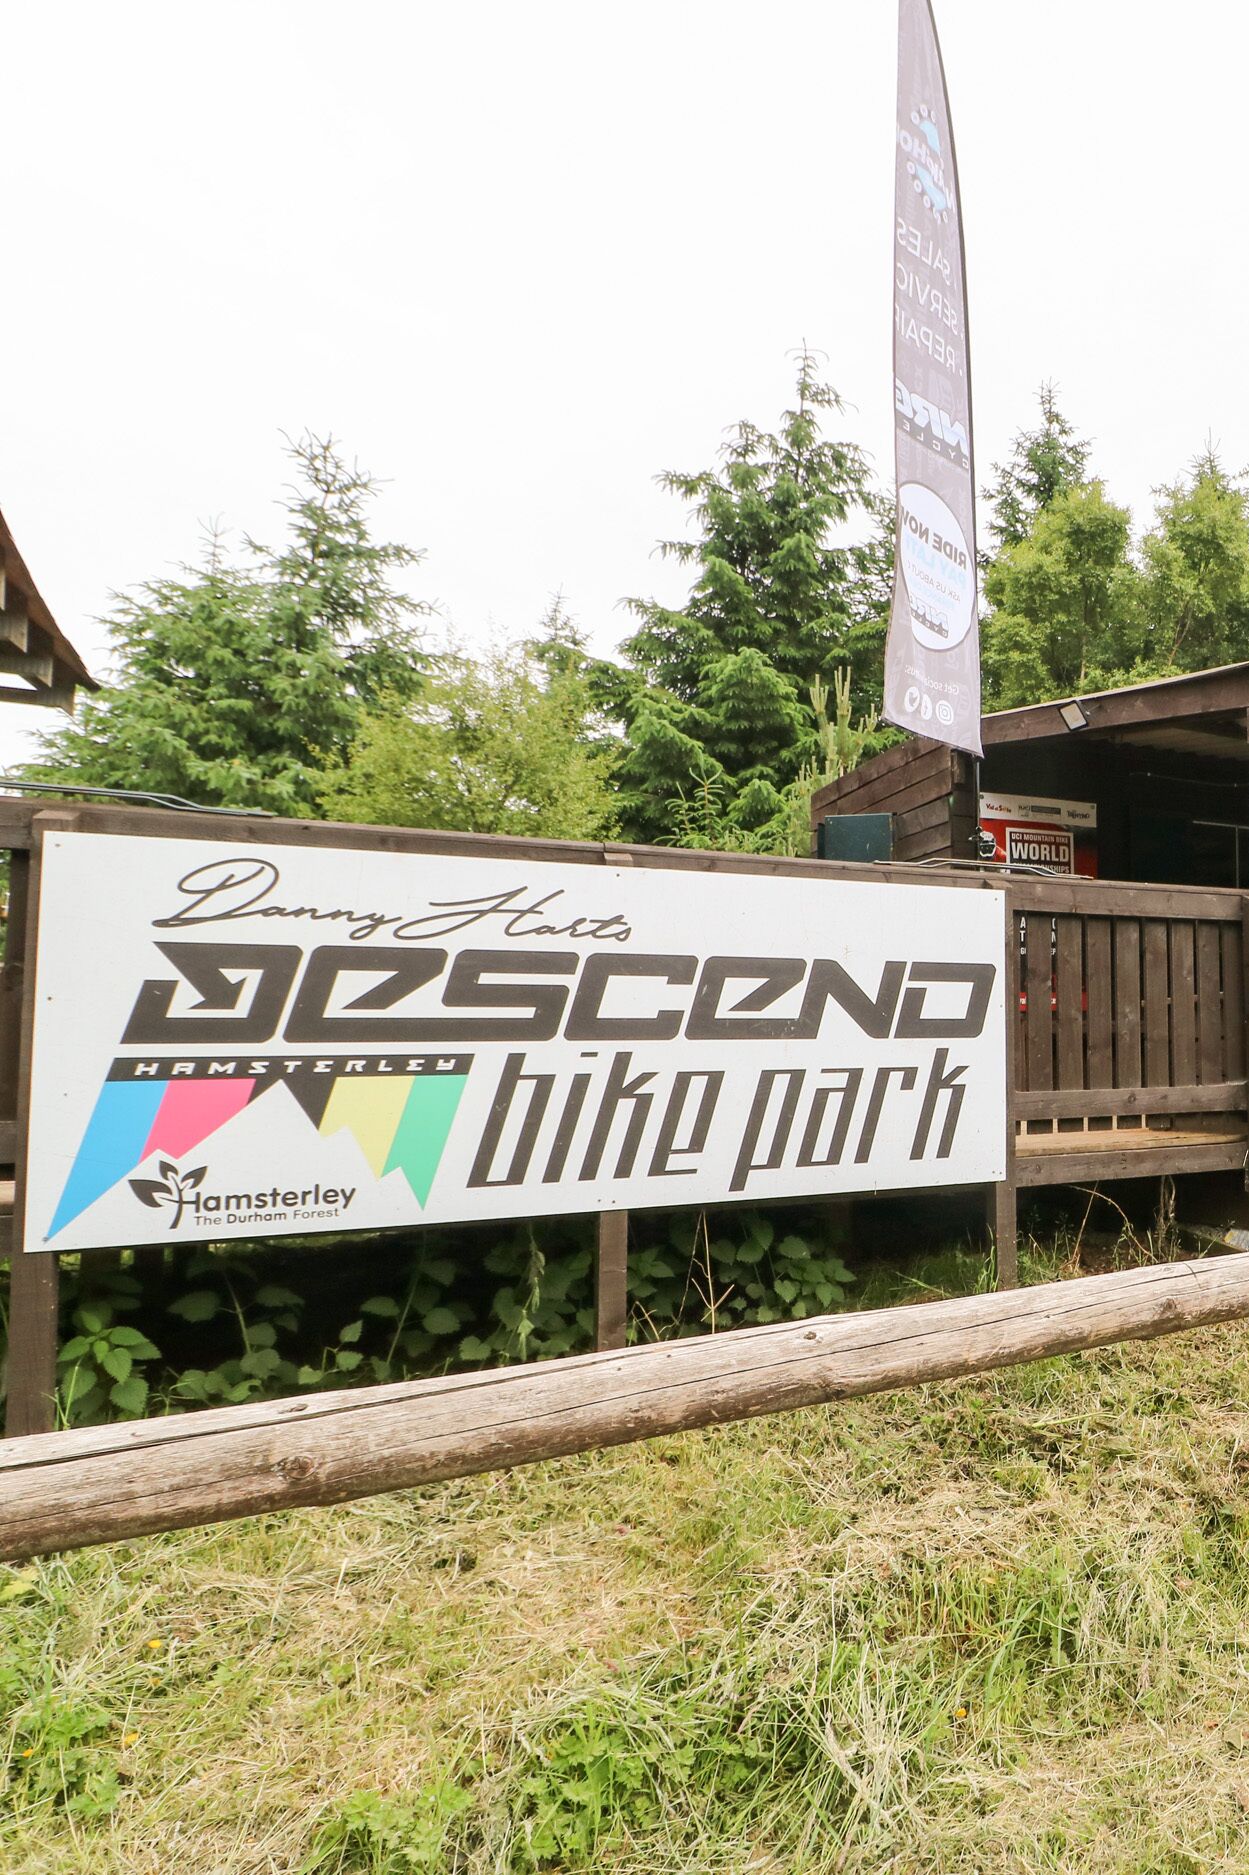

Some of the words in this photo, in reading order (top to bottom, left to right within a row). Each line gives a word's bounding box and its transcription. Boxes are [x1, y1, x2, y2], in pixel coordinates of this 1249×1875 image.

[1011, 842, 1070, 862] WORLD
[151, 858, 402, 940] Danny
[133, 1058, 458, 1077] HAMSTERLEY
[466, 1052, 725, 1189] bike
[729, 1048, 970, 1193] park
[170, 1183, 357, 1214] Hamsterley
[193, 1215, 222, 1227] The
[226, 1212, 288, 1225] Durham
[292, 1208, 340, 1220] Forest
